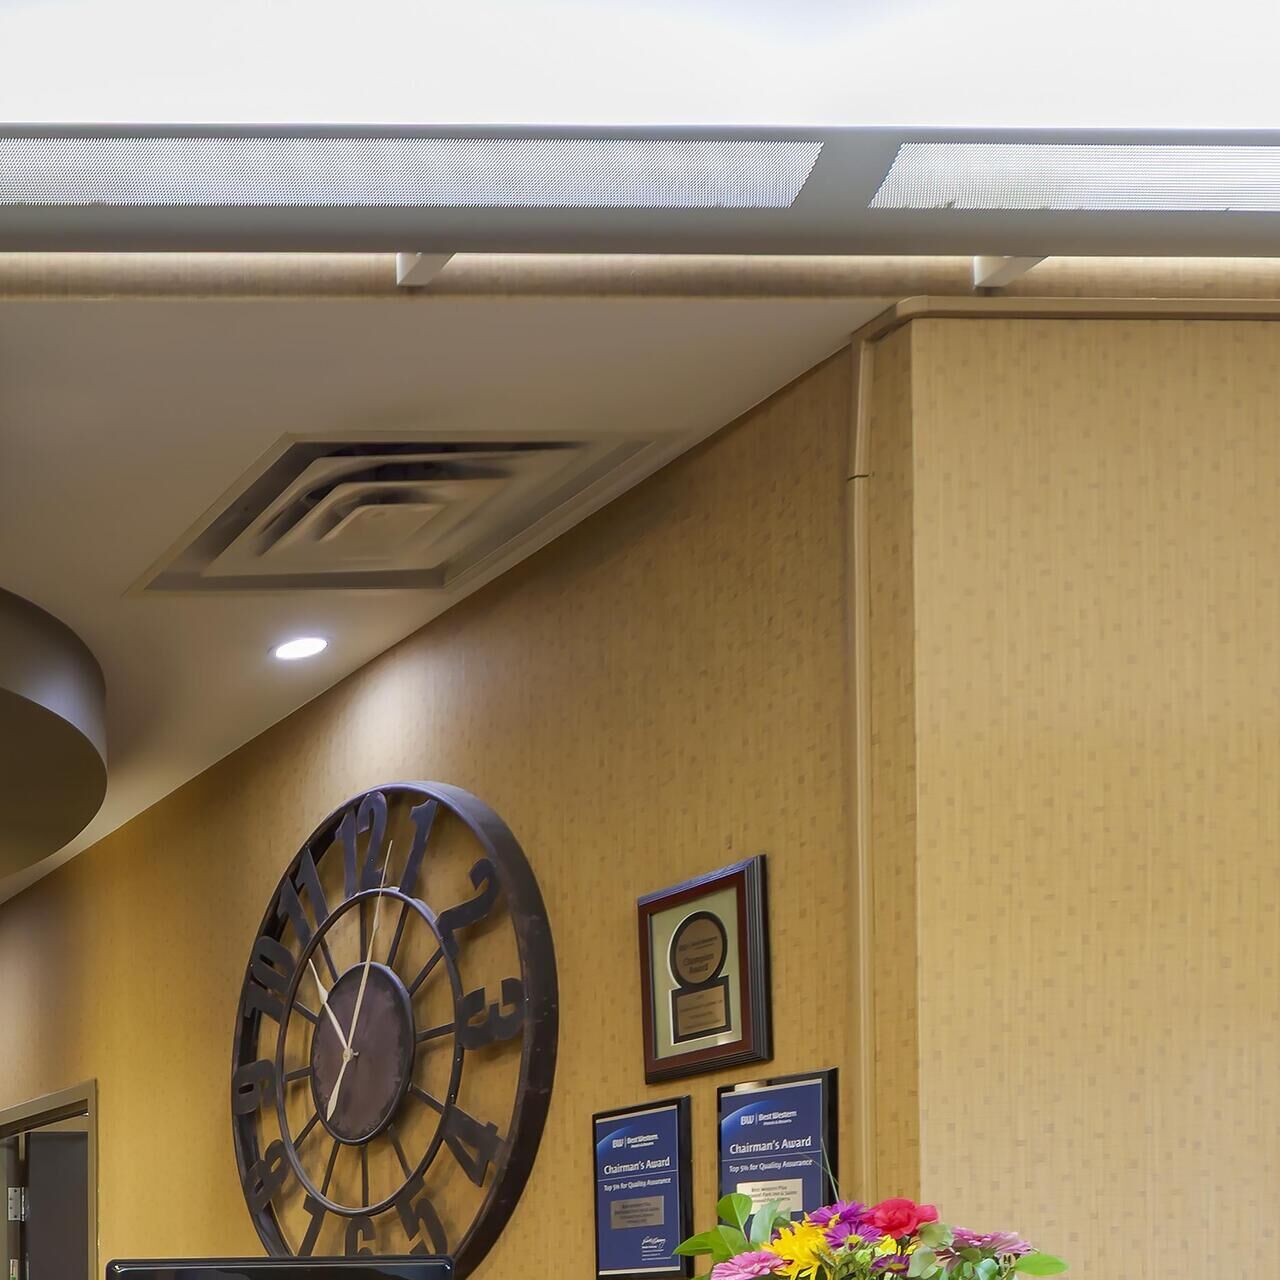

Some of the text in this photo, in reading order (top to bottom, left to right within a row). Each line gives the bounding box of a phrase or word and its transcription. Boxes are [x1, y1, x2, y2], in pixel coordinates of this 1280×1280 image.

[740, 1114, 755, 1126] BW
[730, 1136, 812, 1155] Chairman's Award
[603, 1156, 671, 1175] Chairman's Award
[729, 1165, 739, 1174] Top
[749, 1163, 758, 1171] for
[759, 1161, 781, 1171] Quality
